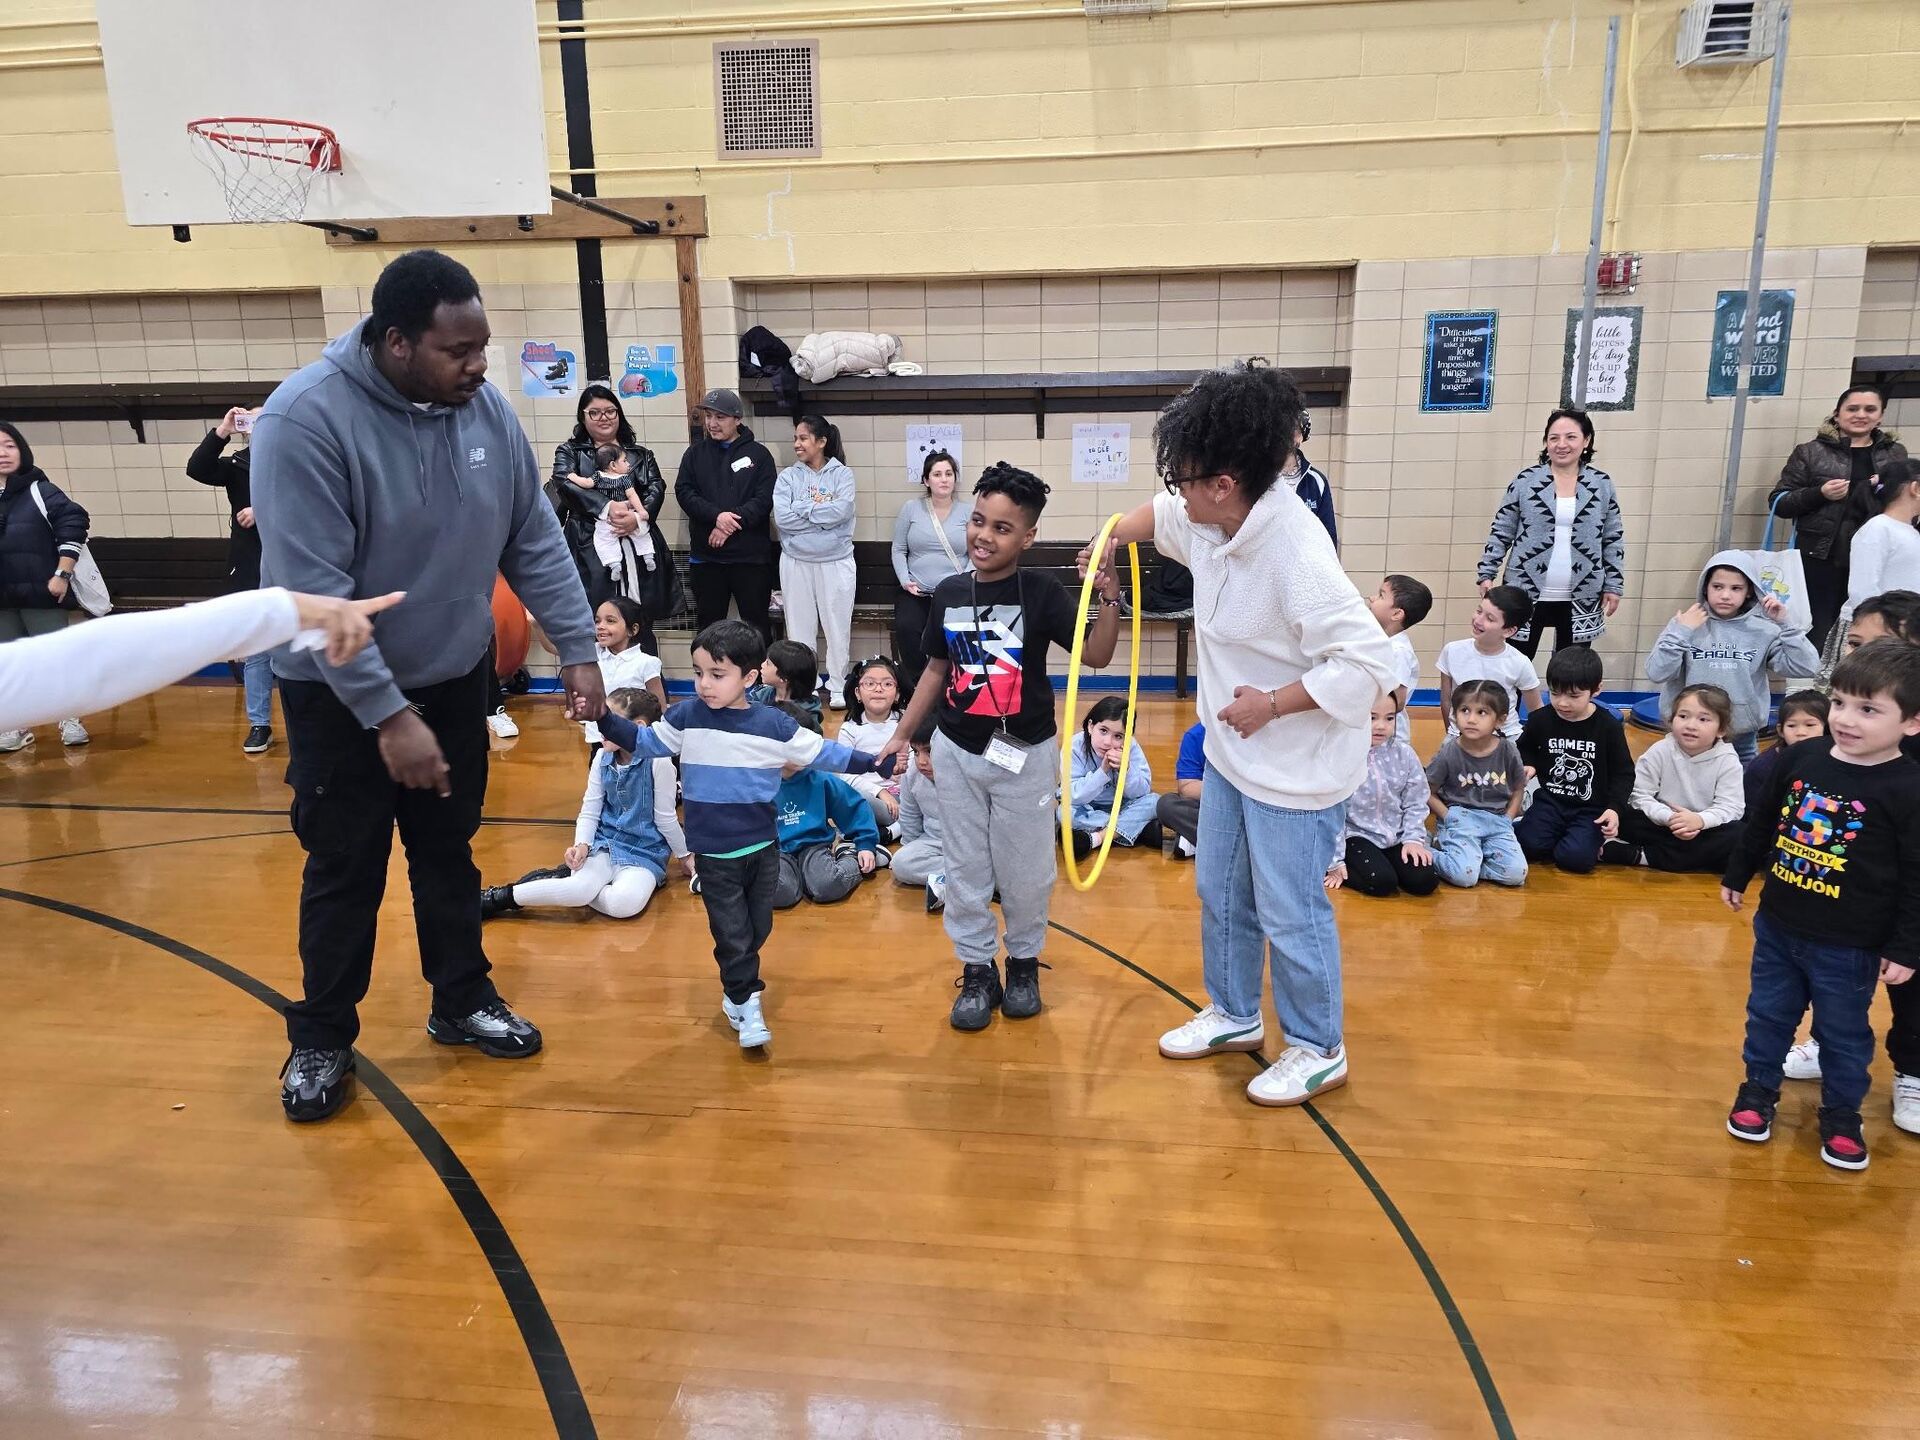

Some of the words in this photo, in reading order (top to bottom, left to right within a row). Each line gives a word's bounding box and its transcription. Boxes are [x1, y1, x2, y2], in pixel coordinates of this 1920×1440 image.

[1727, 312, 1738, 329] A
[1739, 309, 1783, 328] nd
[1596, 326, 1621, 338] little
[1724, 327, 1781, 345] wrd
[1456, 347, 1475, 357] long
[1592, 340, 1625, 350] ogress
[1605, 349, 1625, 363] day
[1735, 345, 1778, 364] NVER
[628, 362, 652, 370] Player
[1437, 360, 1481, 369] Impossible
[1608, 363, 1621, 373] up
[1721, 365, 1778, 377] WATED
[1441, 368, 1467, 378] things
[1598, 371, 1617, 385] big
[1586, 384, 1616, 394] esults
[1690, 646, 1757, 663] EAGLES
[1549, 738, 1596, 752] GAMER
[1581, 751, 1596, 759] ON
[1791, 792, 1840, 846] 5
[1781, 839, 1834, 864] BIRTHDAY
[1780, 850, 1832, 881] BOY
[1771, 861, 1841, 899] AZIMJON
